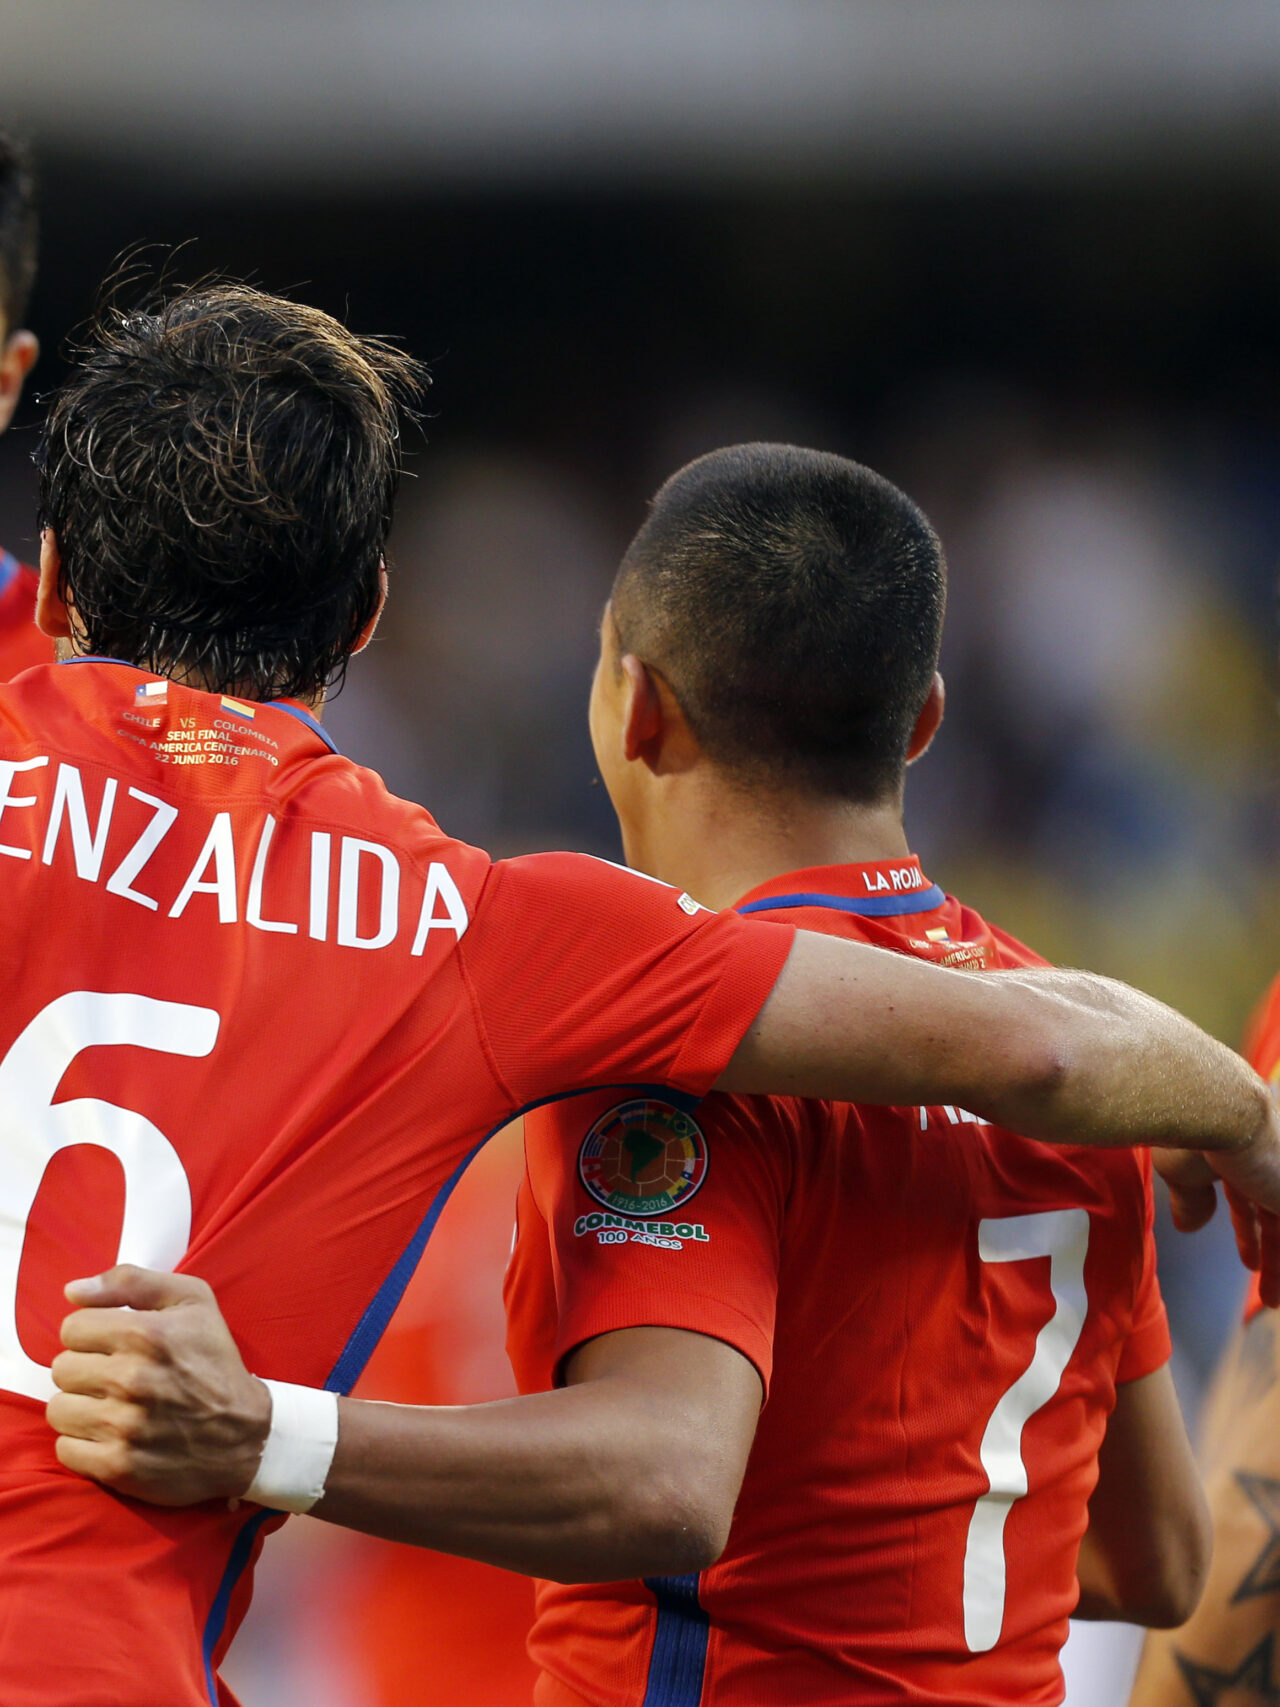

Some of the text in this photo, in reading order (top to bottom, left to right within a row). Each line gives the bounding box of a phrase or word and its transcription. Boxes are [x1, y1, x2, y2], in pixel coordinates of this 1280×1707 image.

[122, 712, 279, 749] CHILE VS COLOMBIA
[166, 729, 233, 742] SEMI FINAL
[149, 742, 202, 753] AMERICA
[203, 741, 279, 766] CENTENARIO
[154, 753, 239, 766] 22 JUNIO 2016
[862, 866, 923, 892] LA ROJA
[611, 1193, 669, 1211] 1916-2016
[574, 1212, 710, 1242] CONMEBOL
[598, 1232, 683, 1250] 100 AÑOS
[962, 1208, 1090, 1653] 7
